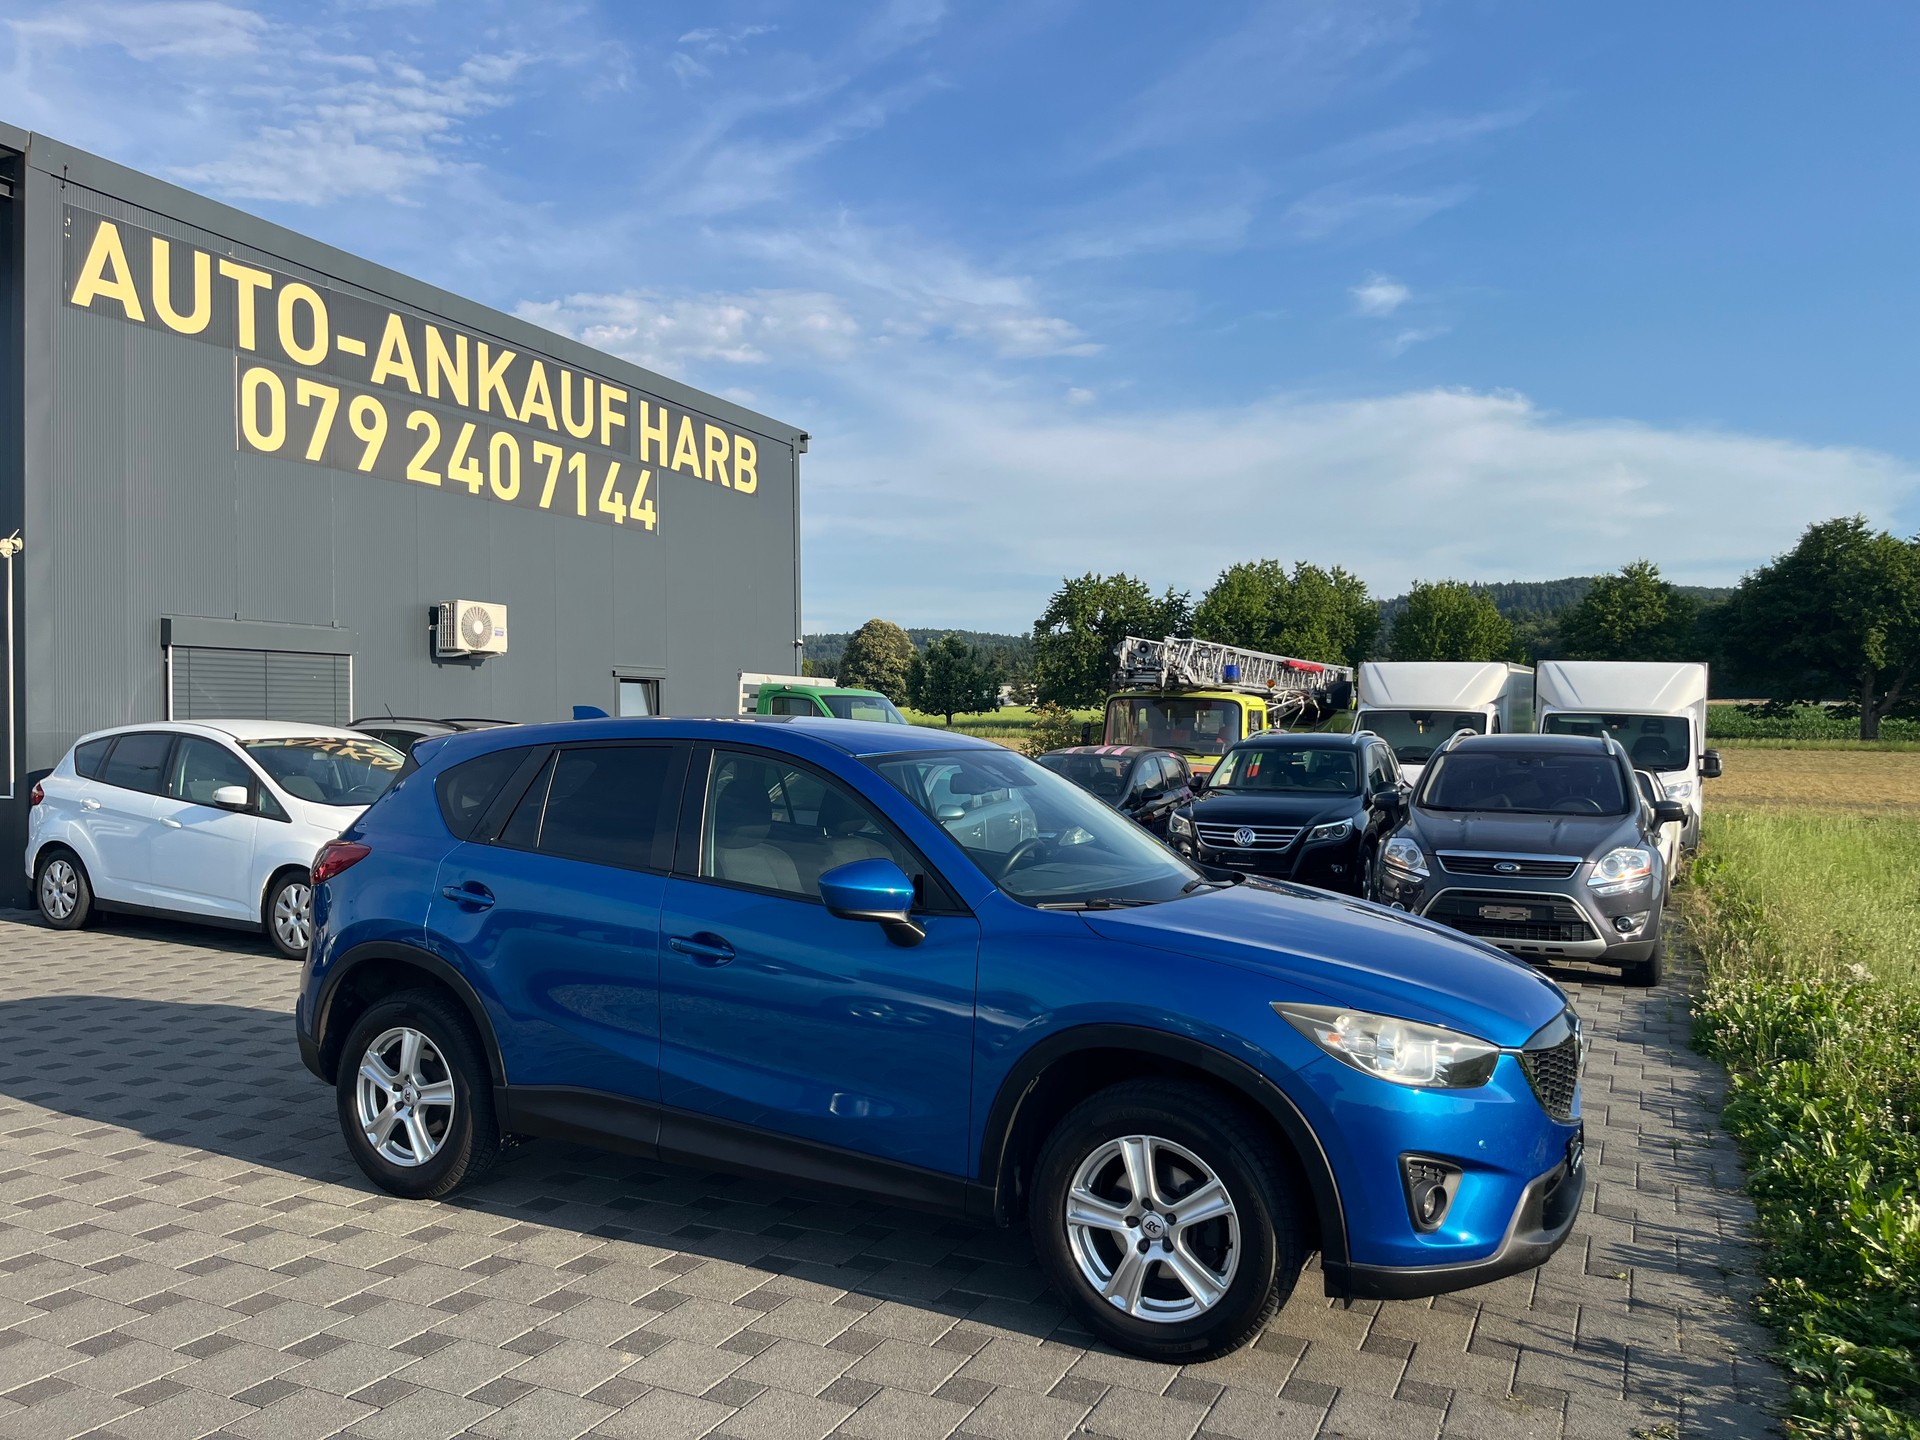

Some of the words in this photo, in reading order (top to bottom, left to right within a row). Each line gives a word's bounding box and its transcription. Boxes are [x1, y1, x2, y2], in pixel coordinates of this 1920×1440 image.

[71, 221, 629, 446] AUTO-ANKAUF
[640, 401, 758, 495] HARB
[241, 367, 388, 472] 079
[406, 410, 521, 501] 240
[1236, 828, 1253, 846] VW
